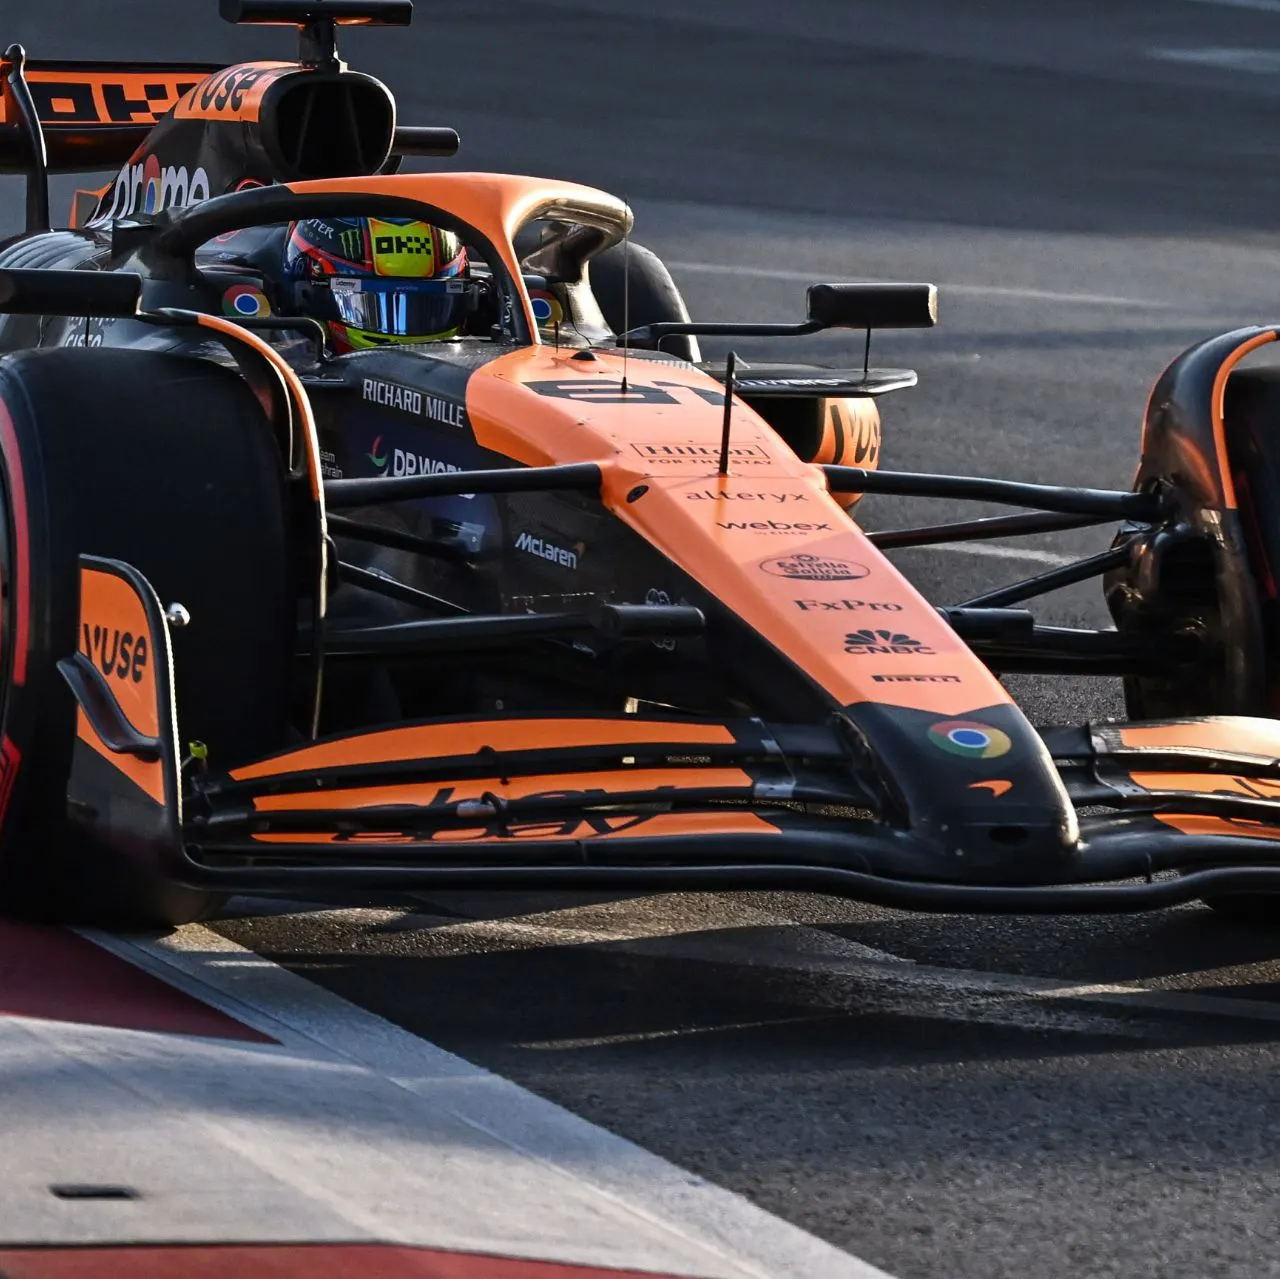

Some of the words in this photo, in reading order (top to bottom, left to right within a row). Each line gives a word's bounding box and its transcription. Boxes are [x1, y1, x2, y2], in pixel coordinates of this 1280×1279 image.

[83, 154, 210, 231] hrome
[375, 236, 431, 255] OKX
[362, 378, 422, 415] RICHARD
[425, 396, 465, 428] MILLE
[645, 446, 756, 456] Hilton
[393, 448, 417, 477] DP
[685, 490, 810, 503] alteryx
[715, 520, 834, 531] webex
[515, 532, 578, 569] McLaren
[793, 599, 903, 612] FxPro
[844, 646, 937, 655] CNBC
